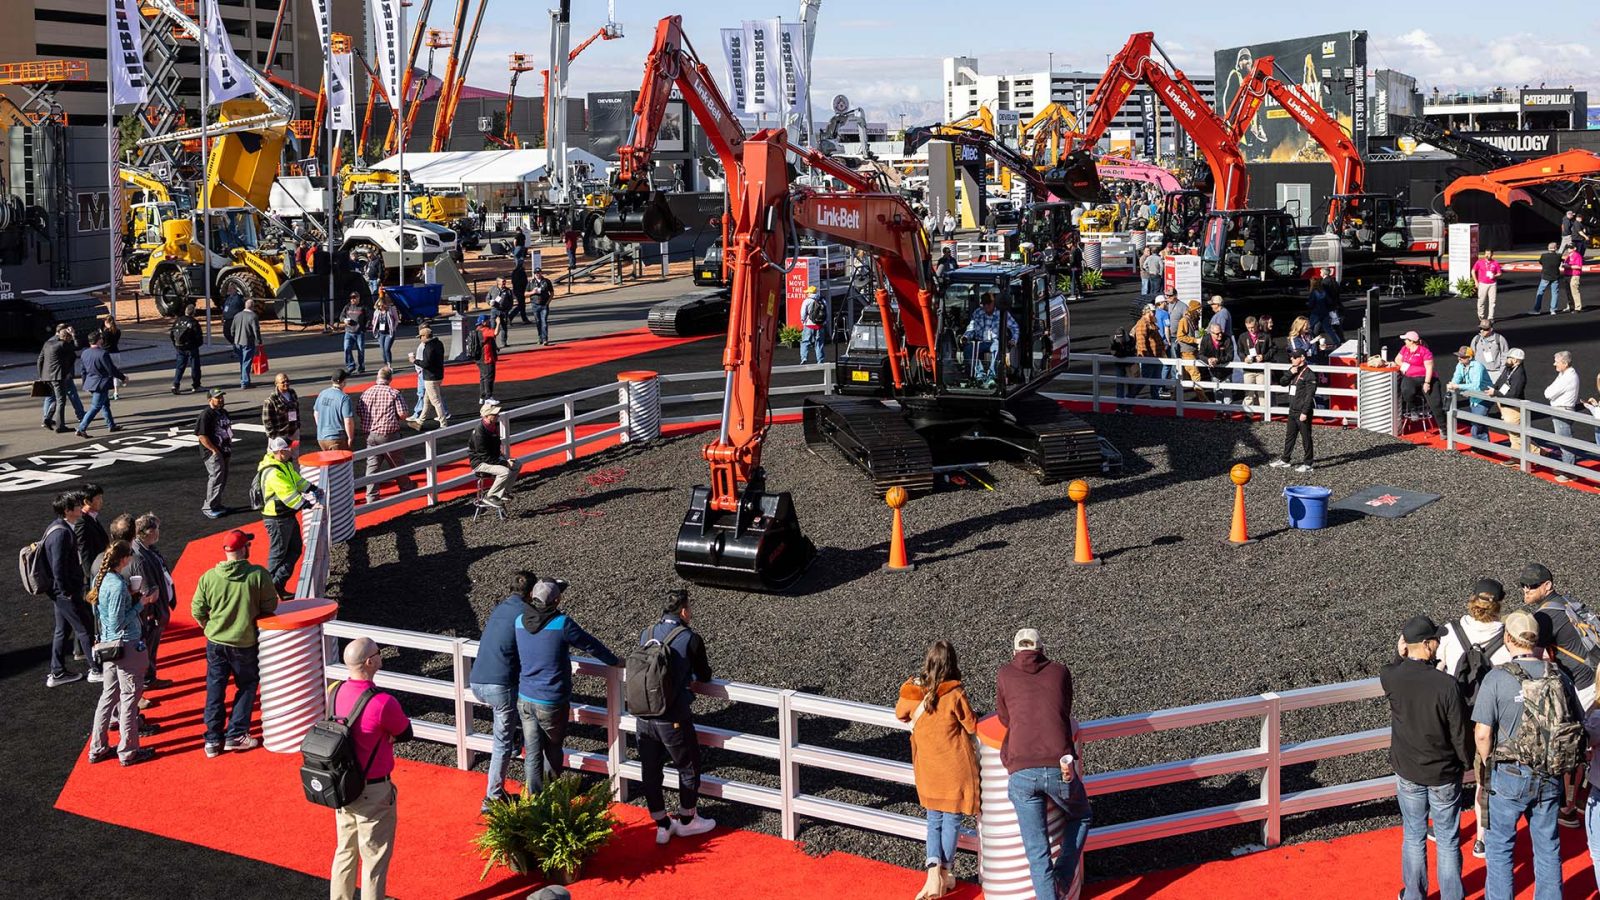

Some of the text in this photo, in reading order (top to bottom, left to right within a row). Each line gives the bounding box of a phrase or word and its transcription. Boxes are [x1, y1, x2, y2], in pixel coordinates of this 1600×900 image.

[1322, 41, 1336, 54] CAT
[1524, 94, 1572, 106] CATERPILLAR
[1144, 95, 1155, 157] DEVELON
[962, 145, 978, 160] Altec
[1011, 178, 1026, 209] Alte
